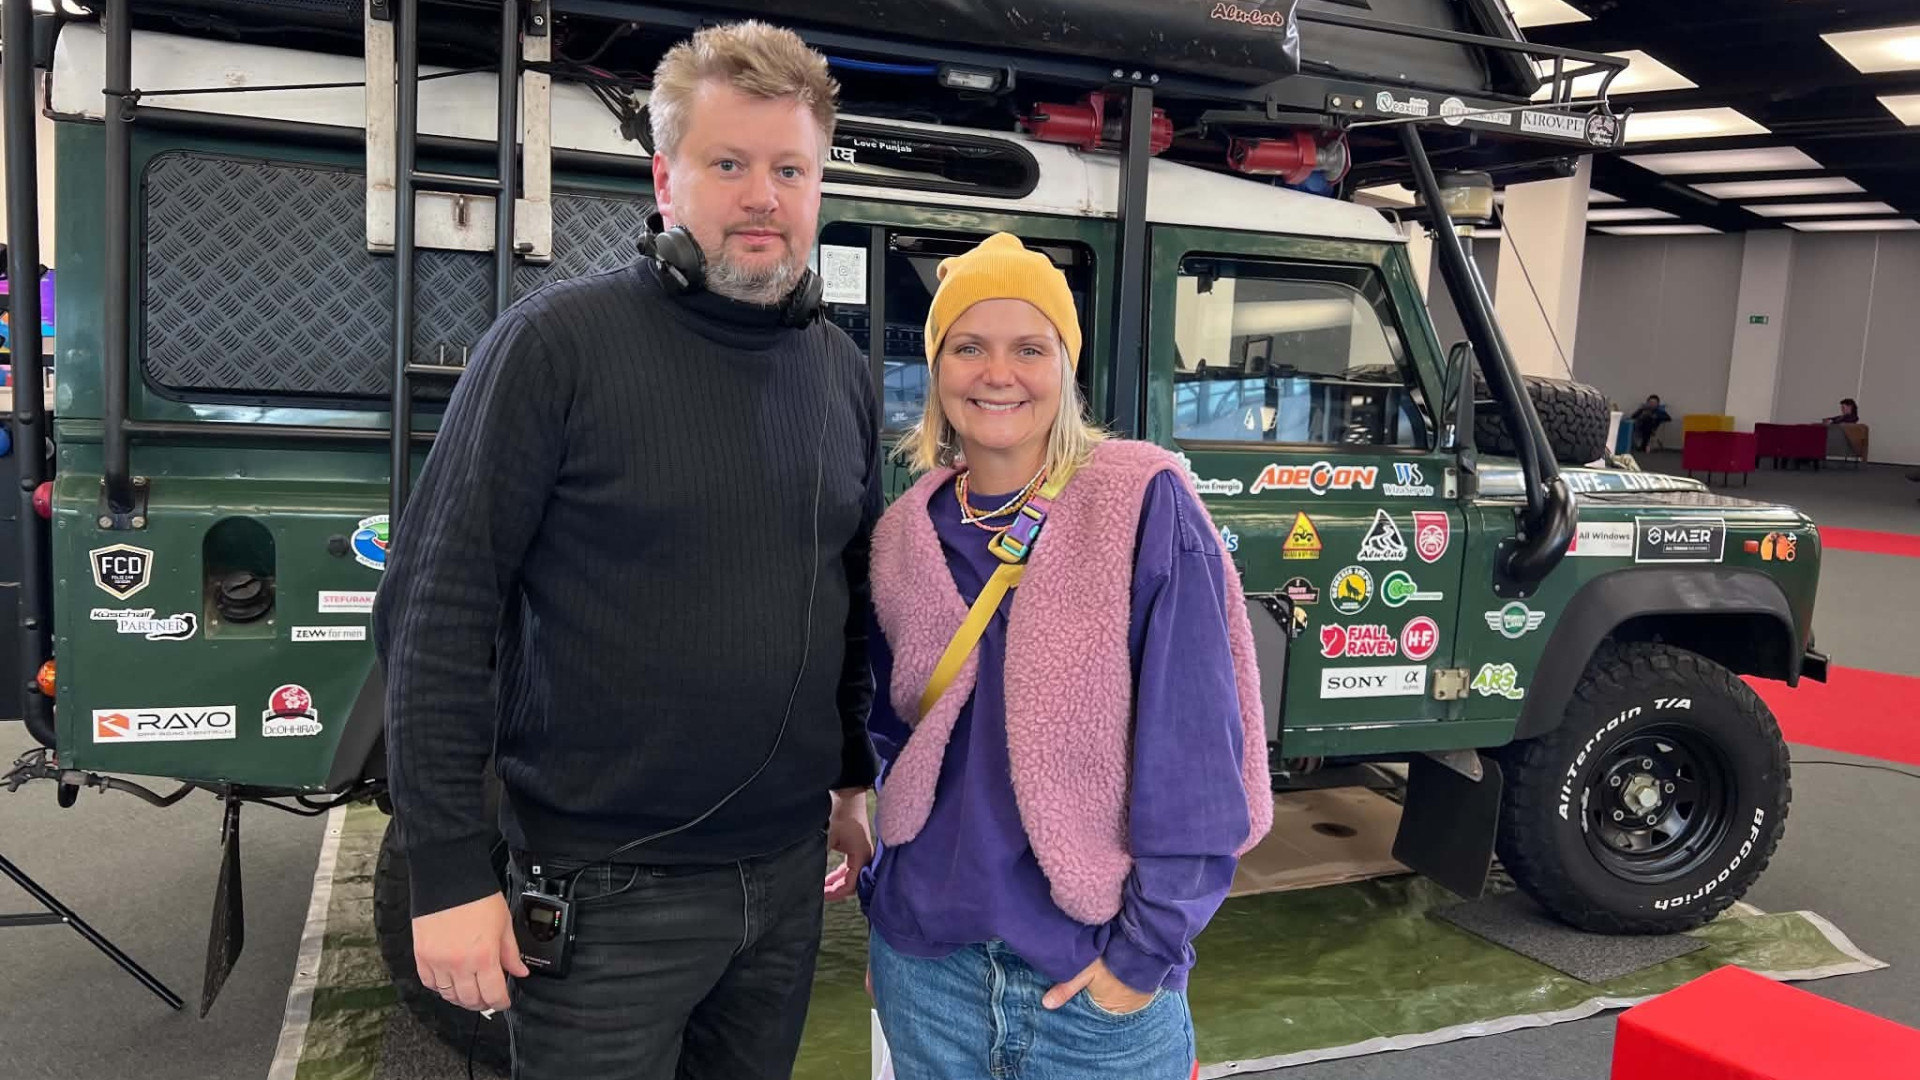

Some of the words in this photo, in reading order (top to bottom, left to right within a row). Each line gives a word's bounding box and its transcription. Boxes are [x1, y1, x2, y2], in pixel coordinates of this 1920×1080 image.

[853, 139, 877, 148] Love
[879, 142, 912, 153] Punjab
[1254, 465, 1375, 491] ADECON
[1395, 464, 1422, 484] WS
[1579, 532, 1590, 540] All
[1593, 532, 1630, 540] Windows
[1664, 530, 1711, 542] MAER
[1359, 550, 1404, 559] Alu-Cab
[102, 556, 142, 575] FCD
[120, 619, 184, 631] PARTNER
[328, 628, 342, 638] for
[343, 629, 362, 638] men
[1348, 626, 1389, 640] FJALL
[1347, 640, 1396, 655] RAVEN
[1327, 675, 1388, 690] SONY
[1472, 669, 1516, 689] ARS
[138, 711, 231, 730] RAYO
[1558, 705, 1642, 821] All-Terrain
[1654, 698, 1692, 710] T/A
[1654, 806, 1765, 911] BFGoodrich
